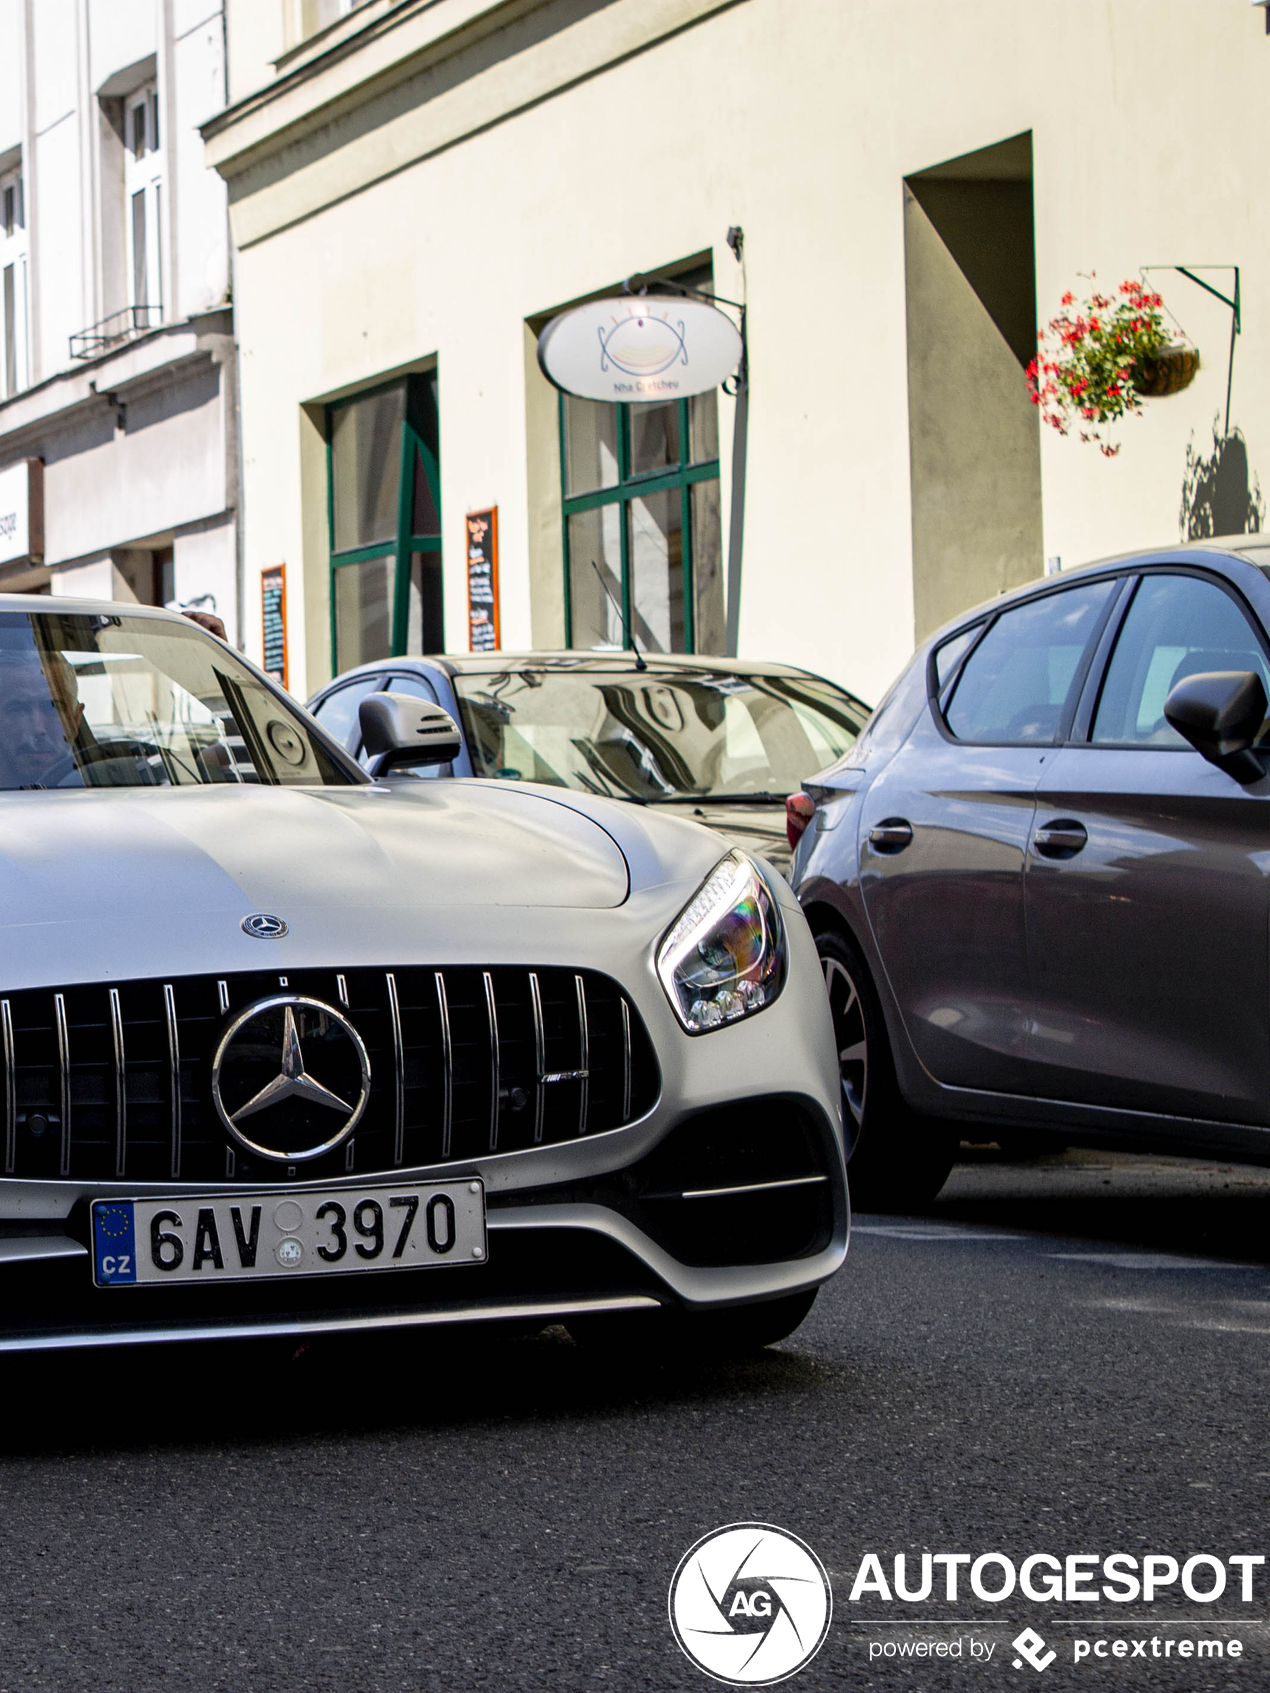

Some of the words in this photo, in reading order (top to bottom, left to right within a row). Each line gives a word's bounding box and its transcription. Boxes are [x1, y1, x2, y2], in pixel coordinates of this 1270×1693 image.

[150, 1204, 262, 1272] 6AV
[315, 1192, 457, 1263] 3970
[102, 1256, 131, 1275] CZ
